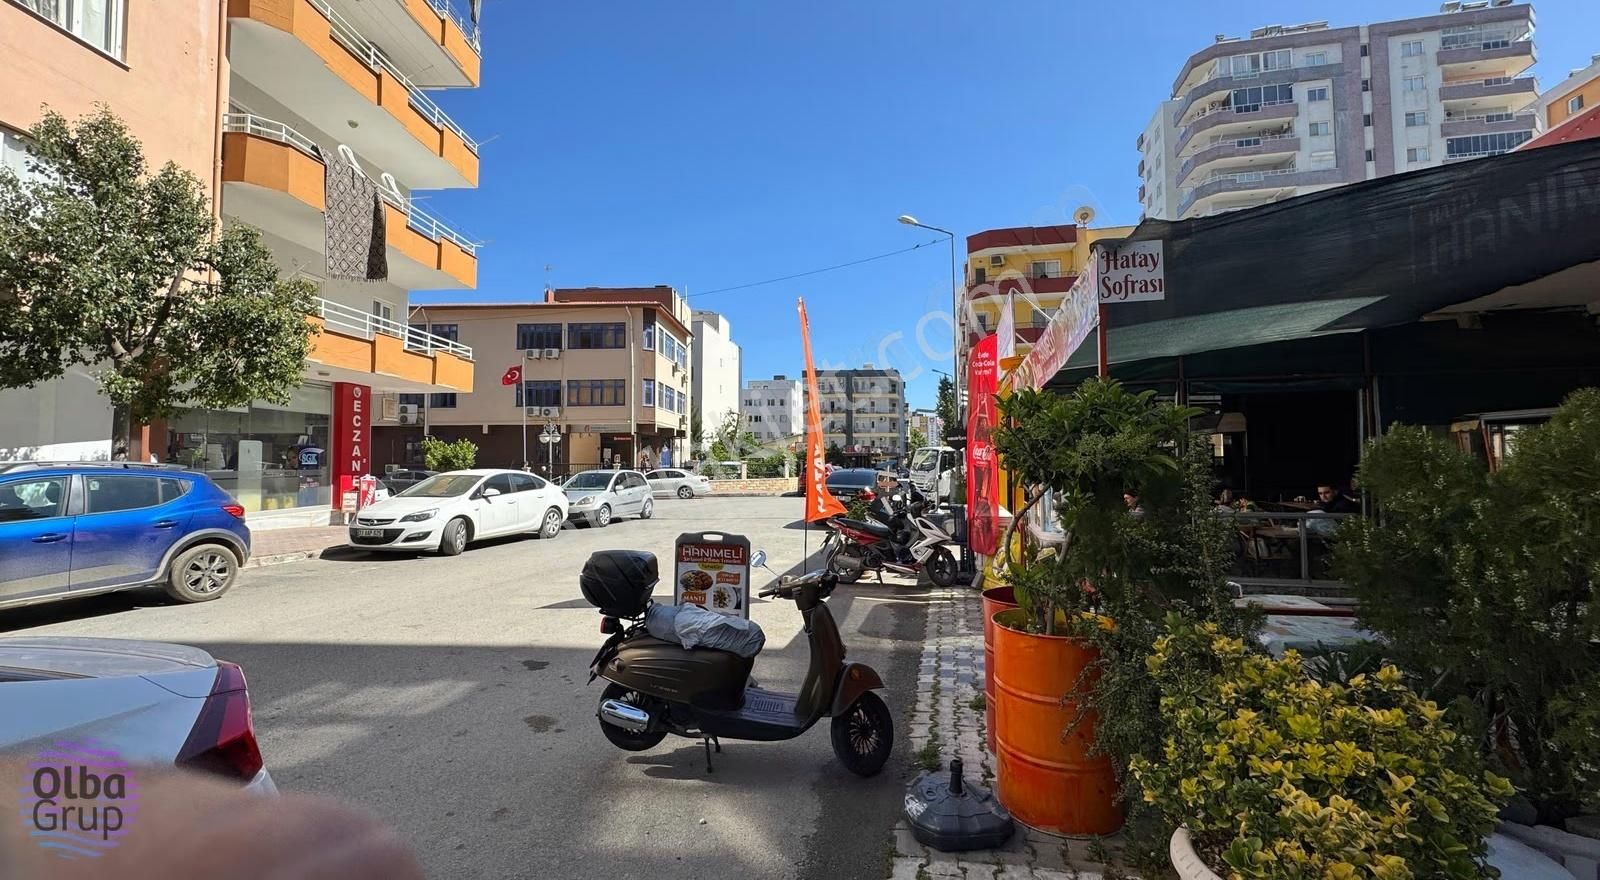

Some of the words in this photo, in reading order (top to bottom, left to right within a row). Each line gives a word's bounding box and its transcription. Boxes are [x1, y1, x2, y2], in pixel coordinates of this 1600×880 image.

[1100, 249, 1160, 275] Hatay
[1101, 273, 1163, 300] Sofrası
[352, 400, 362, 489] ECZANE
[301, 453, 318, 464] SGK
